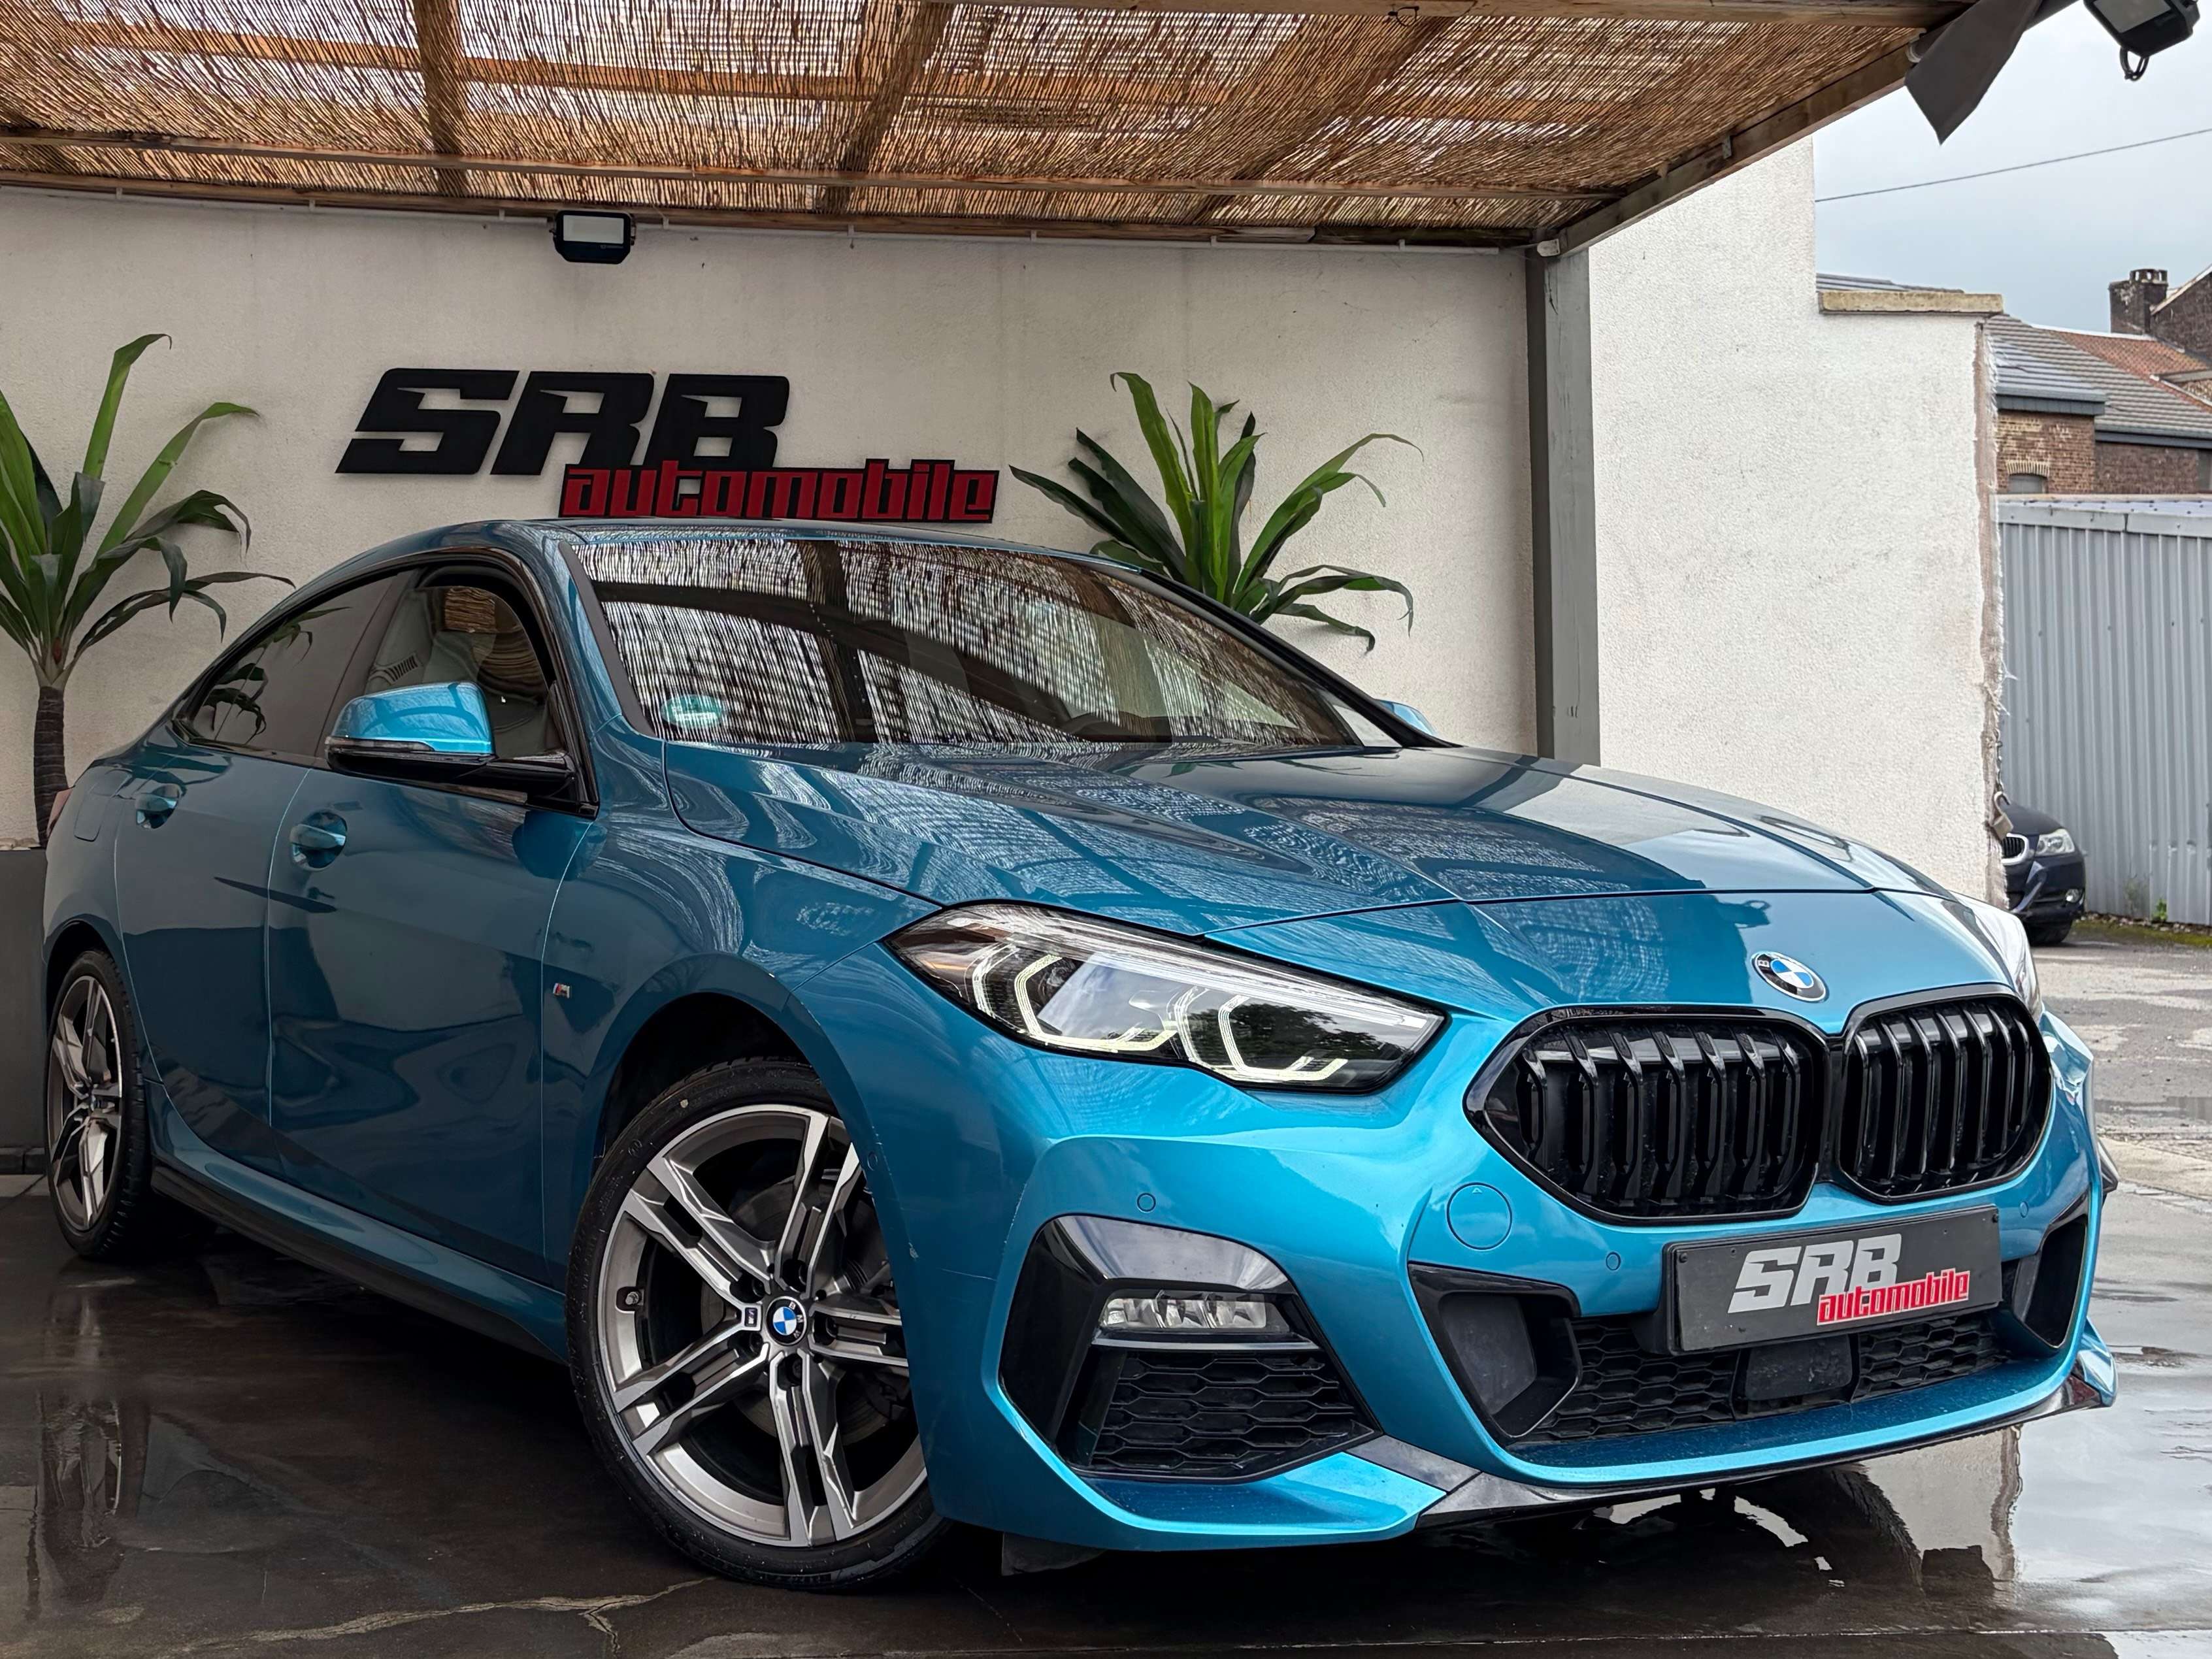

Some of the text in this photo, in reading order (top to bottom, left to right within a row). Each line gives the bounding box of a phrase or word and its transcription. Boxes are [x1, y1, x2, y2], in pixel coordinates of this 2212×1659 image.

[335, 368, 789, 475] SRB
[559, 459, 999, 523] automobile
[1728, 1234, 1901, 1313] SRB
[1817, 1268, 1970, 1325] automobile
